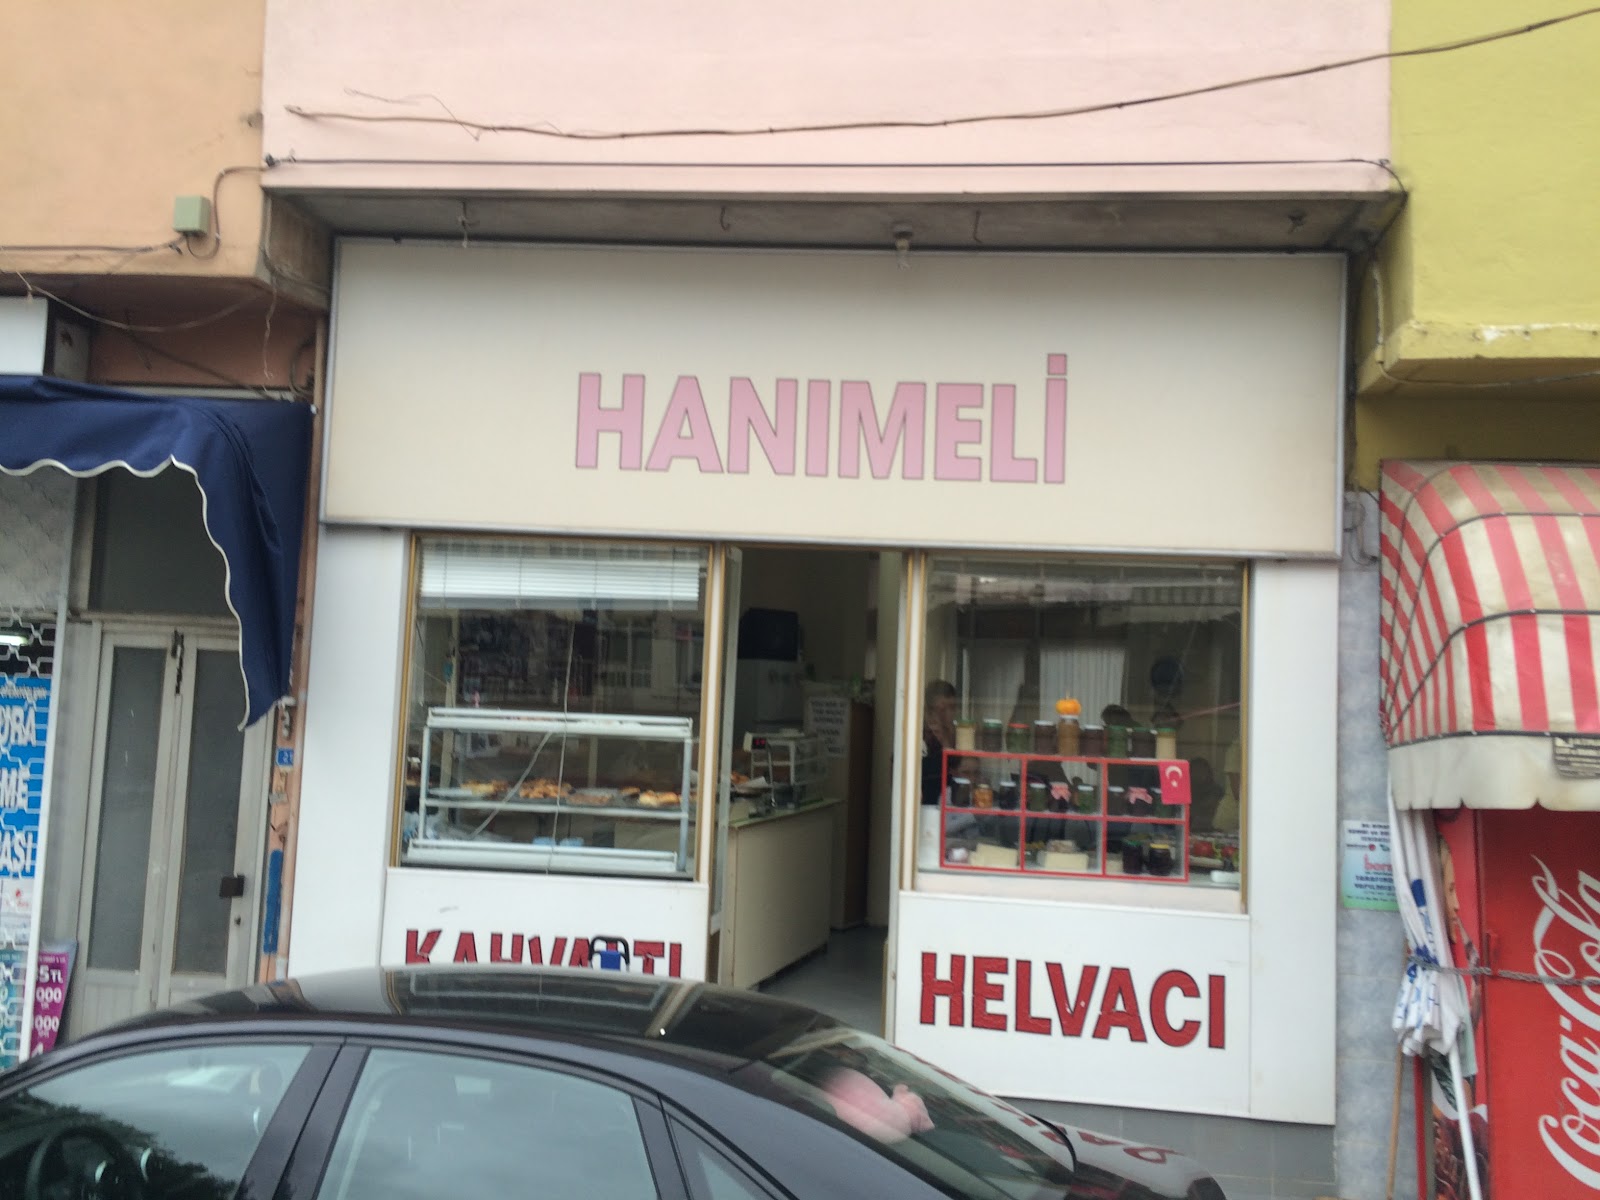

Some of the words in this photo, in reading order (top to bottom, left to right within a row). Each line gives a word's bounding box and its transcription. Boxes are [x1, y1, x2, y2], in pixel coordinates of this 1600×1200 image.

[575, 352, 1067, 485] HANIMELİ
[405, 928, 682, 978] KAHVATI
[919, 951, 1225, 1050] HELVACI
